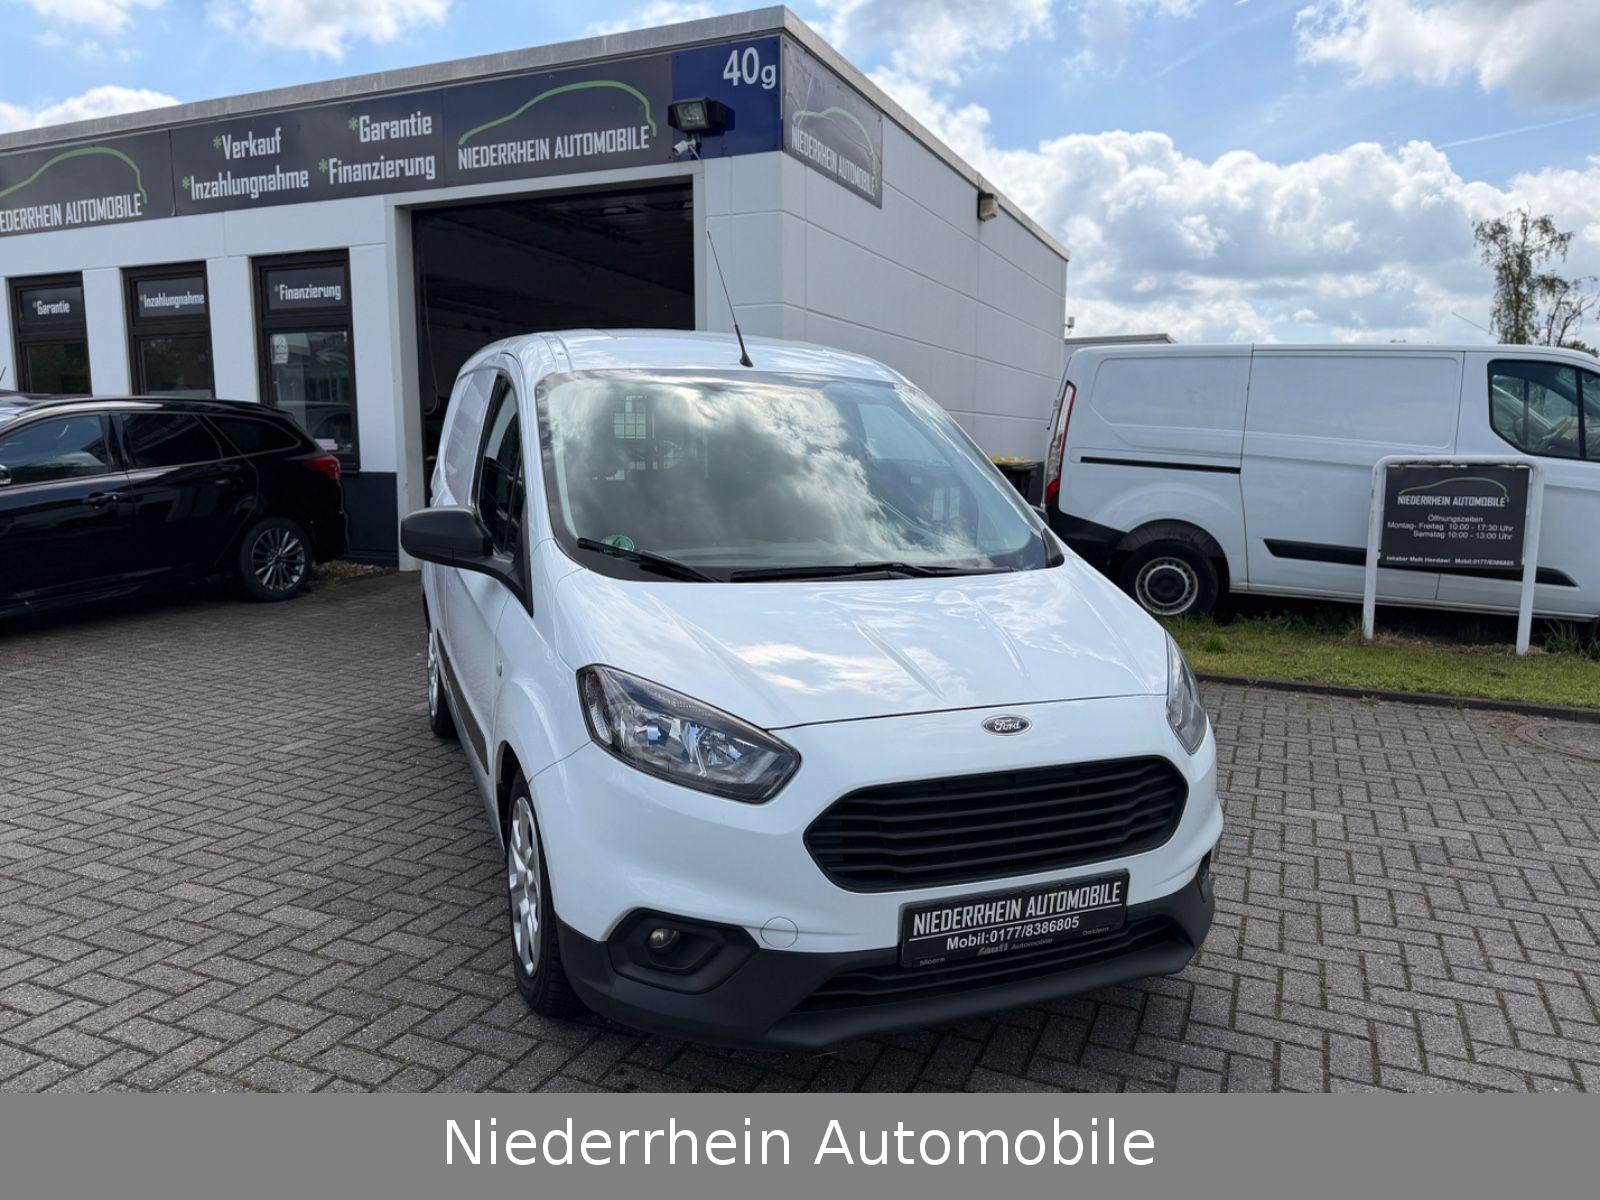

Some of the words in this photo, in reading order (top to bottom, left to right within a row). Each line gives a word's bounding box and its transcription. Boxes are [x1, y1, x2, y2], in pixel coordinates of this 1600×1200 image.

[723, 47, 777, 90] 40g
[359, 111, 433, 143] Garantie
[222, 127, 282, 160] Verkauf
[458, 138, 550, 170] NIEDERRHEIN
[554, 125, 650, 159] AUTOMOBILE
[328, 155, 436, 185] Finanzierung
[791, 124, 837, 175] NIEDERRHEIN
[838, 155, 875, 197] AUTOMOBILE
[191, 165, 309, 200] Inzahlungnahme
[65, 193, 142, 225] AUTOMOBILE
[36, 299, 70, 316] Garantie
[143, 290, 205, 309] Inzahlungnahme
[279, 283, 342, 301] Finanzierung
[1397, 495, 1450, 506] NIEDERRHEIN
[1452, 496, 1506, 507] AUTOMOBILE
[1413, 530, 1445, 539] Samstag
[1448, 531, 1468, 539] 10:00
[1419, 522, 1444, 531] Freitag
[1449, 523, 1469, 531] 10:00
[1499, 524, 1514, 532] Uhr
[994, 718, 1022, 731] Ford
[912, 898, 1023, 937] NIEDERRHEIN
[1025, 881, 1122, 918] AUTOMOBILE
[946, 915, 1080, 950] Mobil:0177/8386805
